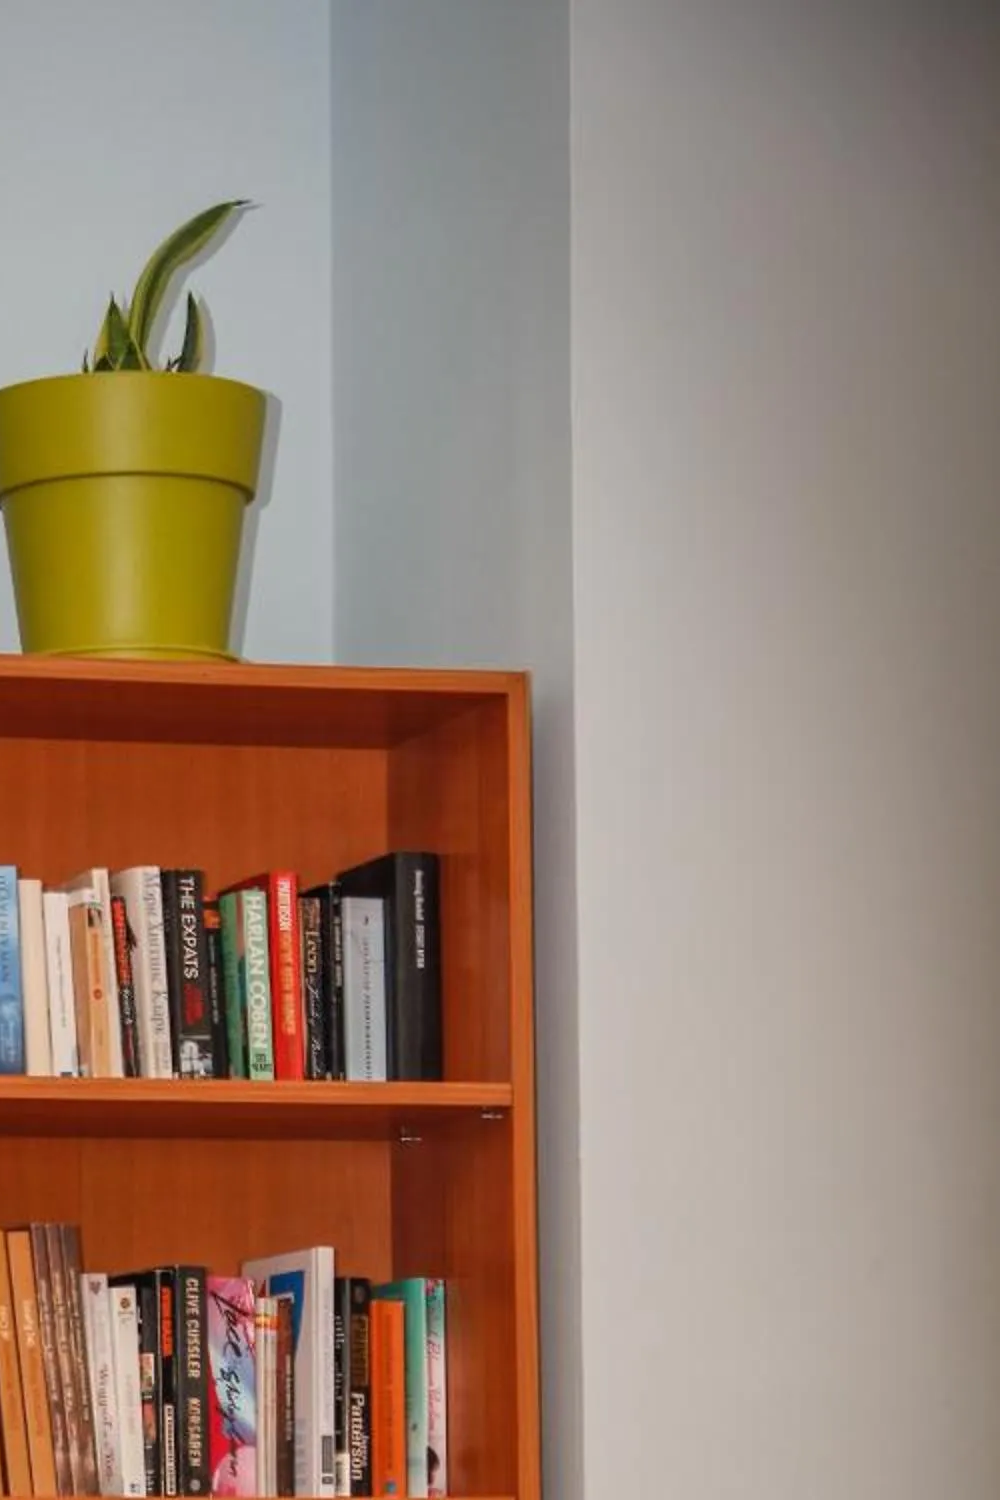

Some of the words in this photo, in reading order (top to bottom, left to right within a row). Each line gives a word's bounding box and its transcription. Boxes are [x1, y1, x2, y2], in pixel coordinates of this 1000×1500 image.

[180, 877, 195, 909] THE
[182, 914, 199, 979] EXPATS
[248, 895, 266, 975] HARLAN
[250, 980, 268, 1049] COBEN
[186, 1277, 200, 1316] CLIVE
[186, 1319, 201, 1379] CUSSLER
[188, 1397, 202, 1468] KORSAREN
[350, 1392, 366, 1480] Patterson
